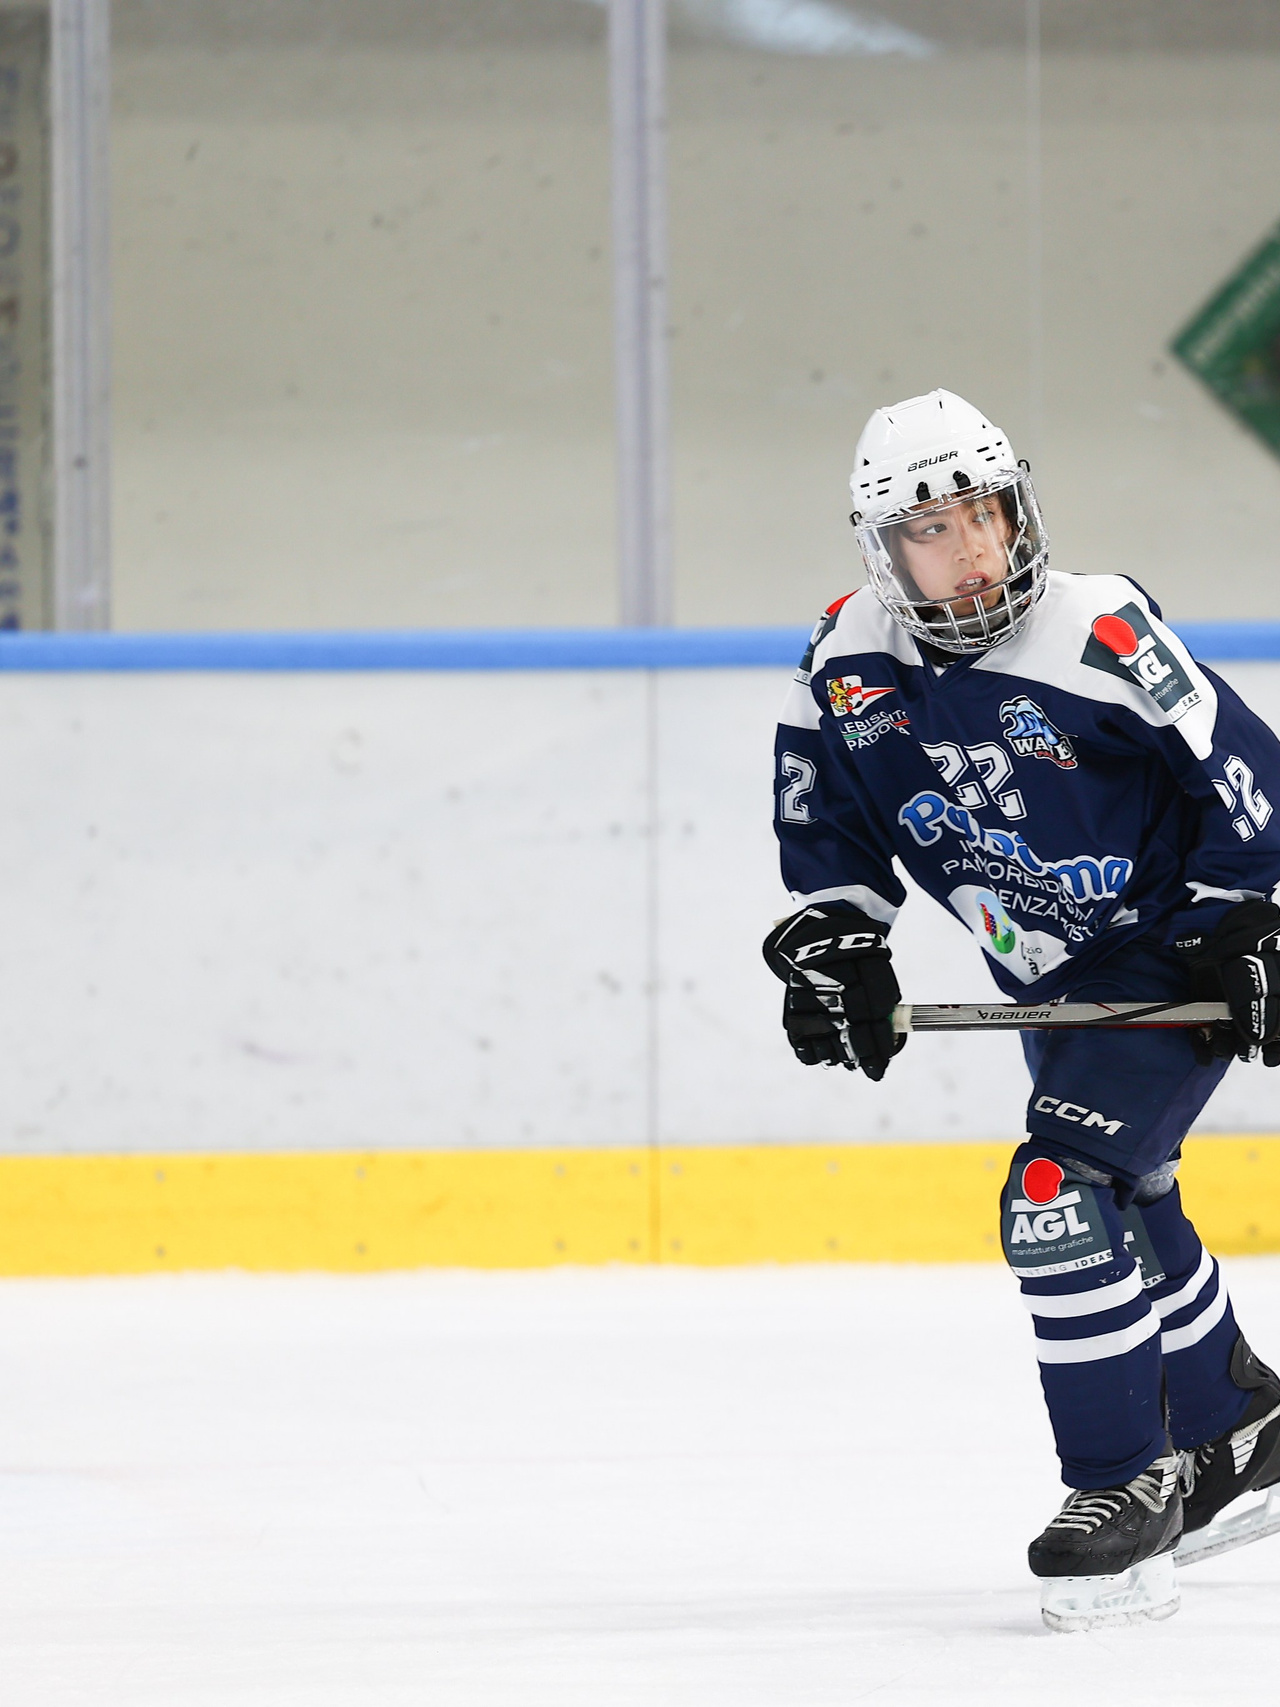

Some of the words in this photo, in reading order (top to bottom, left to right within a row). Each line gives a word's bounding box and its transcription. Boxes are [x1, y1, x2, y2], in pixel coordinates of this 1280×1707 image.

[907, 450, 959, 472] BAUER
[919, 741, 1028, 821] 22
[989, 884, 1058, 921] ENZA
[1175, 936, 1202, 949] CCM
[990, 1011, 1051, 1020] BAUER
[1250, 1001, 1260, 1034] CCM
[1034, 1095, 1125, 1136] CCM
[1010, 1206, 1091, 1244] AGL
[1057, 1235, 1095, 1252] grafiche
[1075, 1252, 1113, 1268] IDEAS
